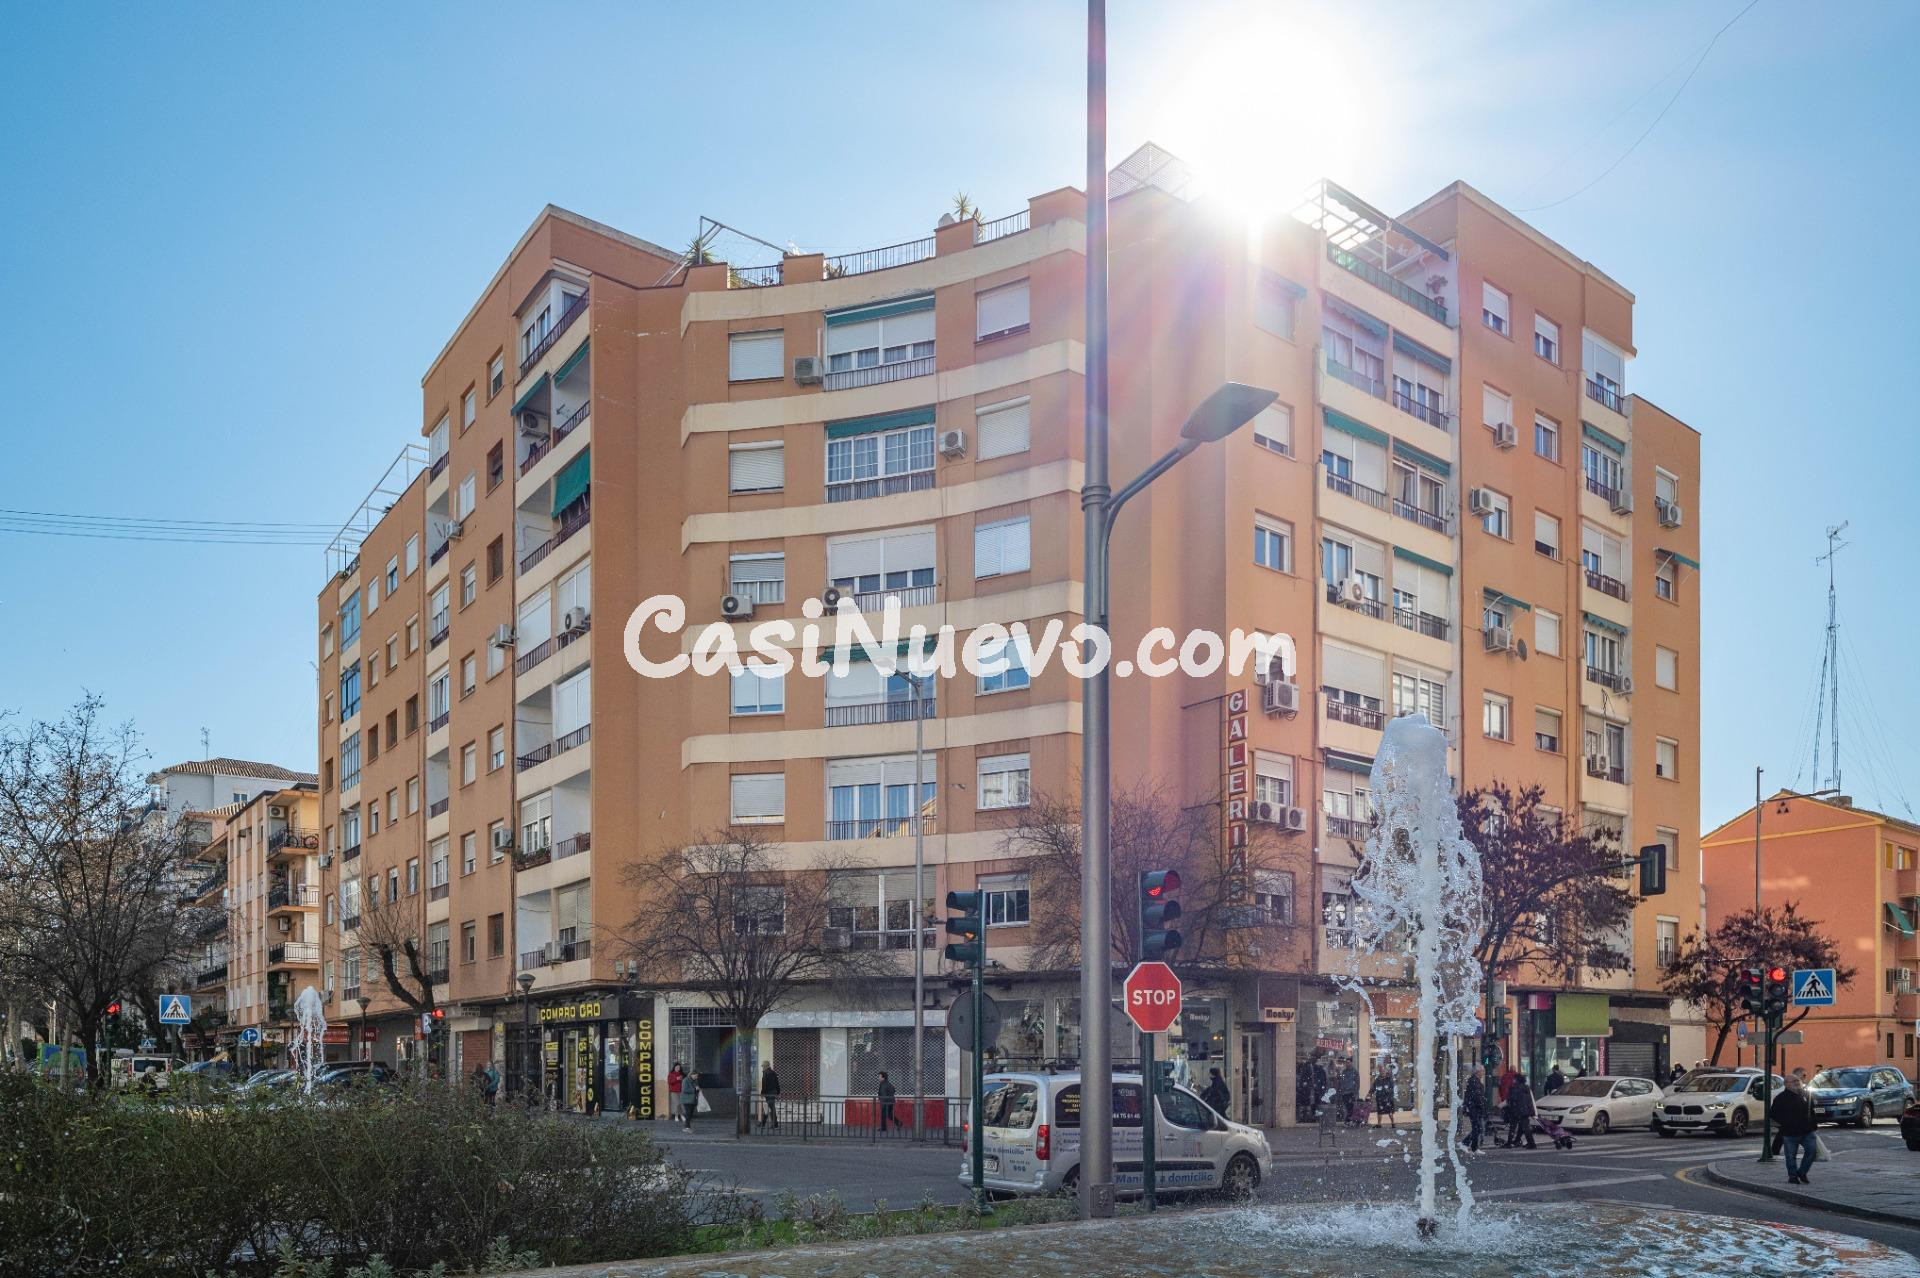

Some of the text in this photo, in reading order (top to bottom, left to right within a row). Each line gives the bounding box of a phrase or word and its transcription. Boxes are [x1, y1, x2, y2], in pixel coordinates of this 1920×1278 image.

[1132, 989, 1176, 1006] STOP
[540, 1006, 576, 1020] COMPRO
[639, 1020, 652, 1082] COMPRO
[1168, 1172, 1214, 1183] domicilio
